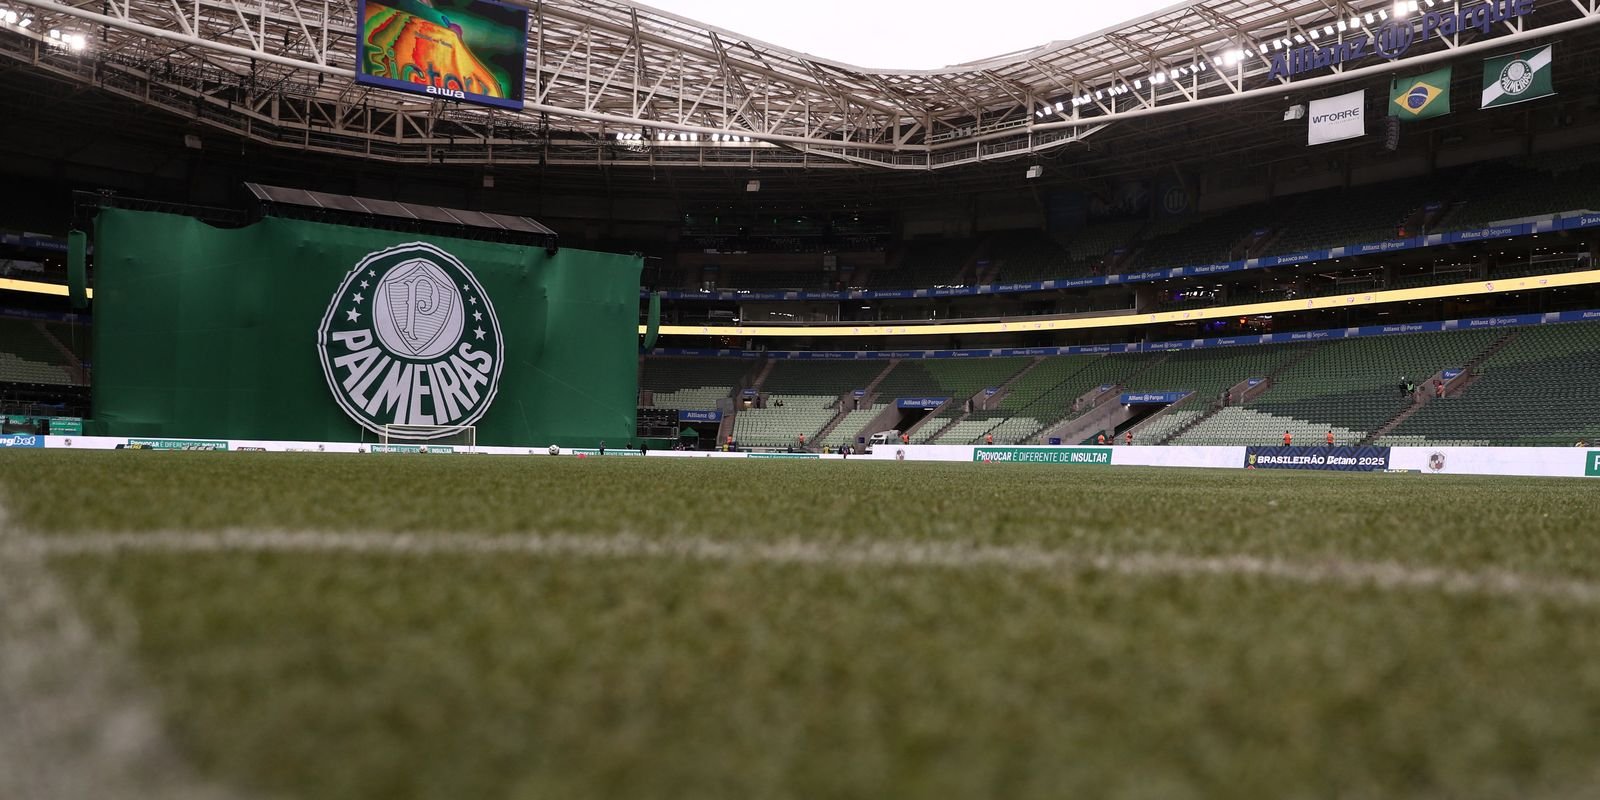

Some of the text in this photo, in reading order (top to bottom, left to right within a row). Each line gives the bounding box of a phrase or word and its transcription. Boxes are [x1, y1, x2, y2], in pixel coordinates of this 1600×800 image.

[1267, 0, 1533, 80] Allianz Parque
[1501, 72, 1532, 93] PALMEIRAS
[426, 85, 465, 99] aiwa
[1312, 107, 1360, 124] WTORRE
[1461, 227, 1511, 239] Allianz Seguros
[1362, 241, 1405, 251] Allianz Parque
[332, 329, 493, 426] PALMEIRAS
[977, 449, 1107, 462] PROVOCAR É DIFERENTE DE INSULTAR
[1257, 454, 1385, 465] BRASILEIRÃO Betano 2025
